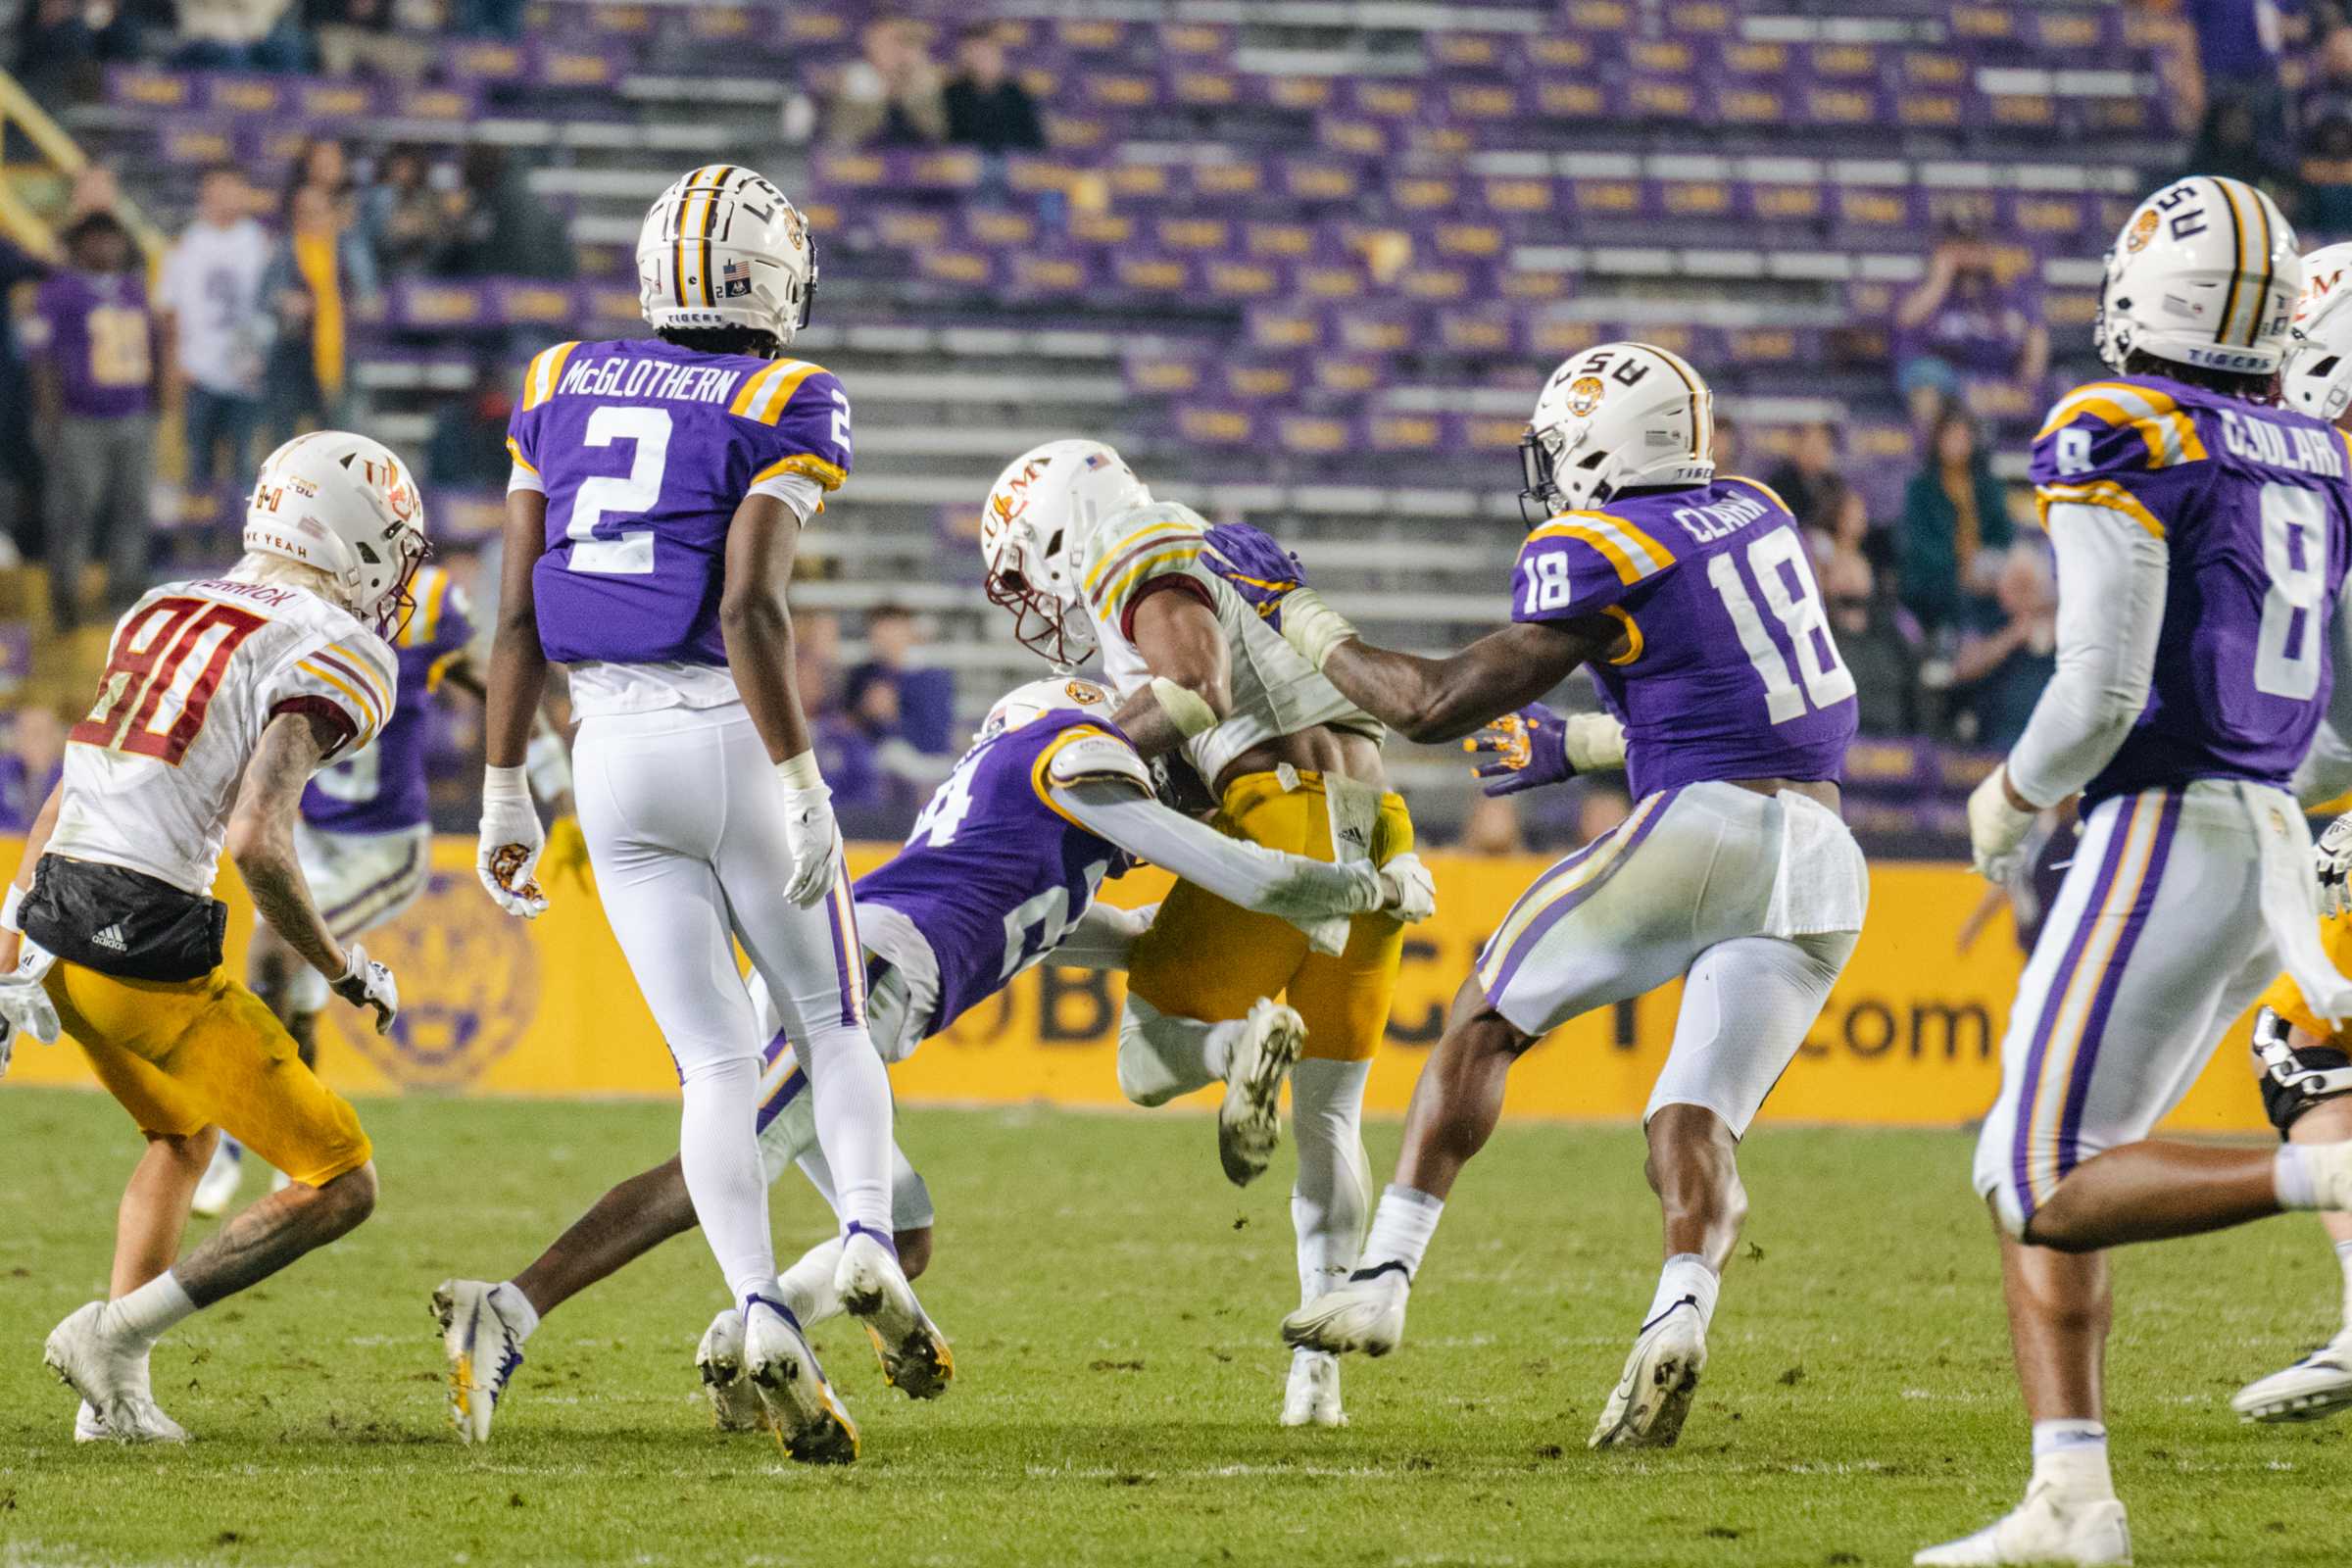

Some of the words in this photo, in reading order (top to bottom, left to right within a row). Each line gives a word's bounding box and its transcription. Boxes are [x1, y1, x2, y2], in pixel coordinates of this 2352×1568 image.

[667, 314, 722, 322] TIGERS
[2188, 348, 2273, 369] TIGERS
[831, 388, 851, 454] 2
[566, 406, 673, 574] 2
[266, 532, 307, 558] YEAH
[1522, 550, 1571, 614] 18
[2255, 481, 2327, 702] 8
[1706, 525, 1858, 726] 18
[66, 597, 270, 769] 80
[91, 934, 128, 953] adidas
